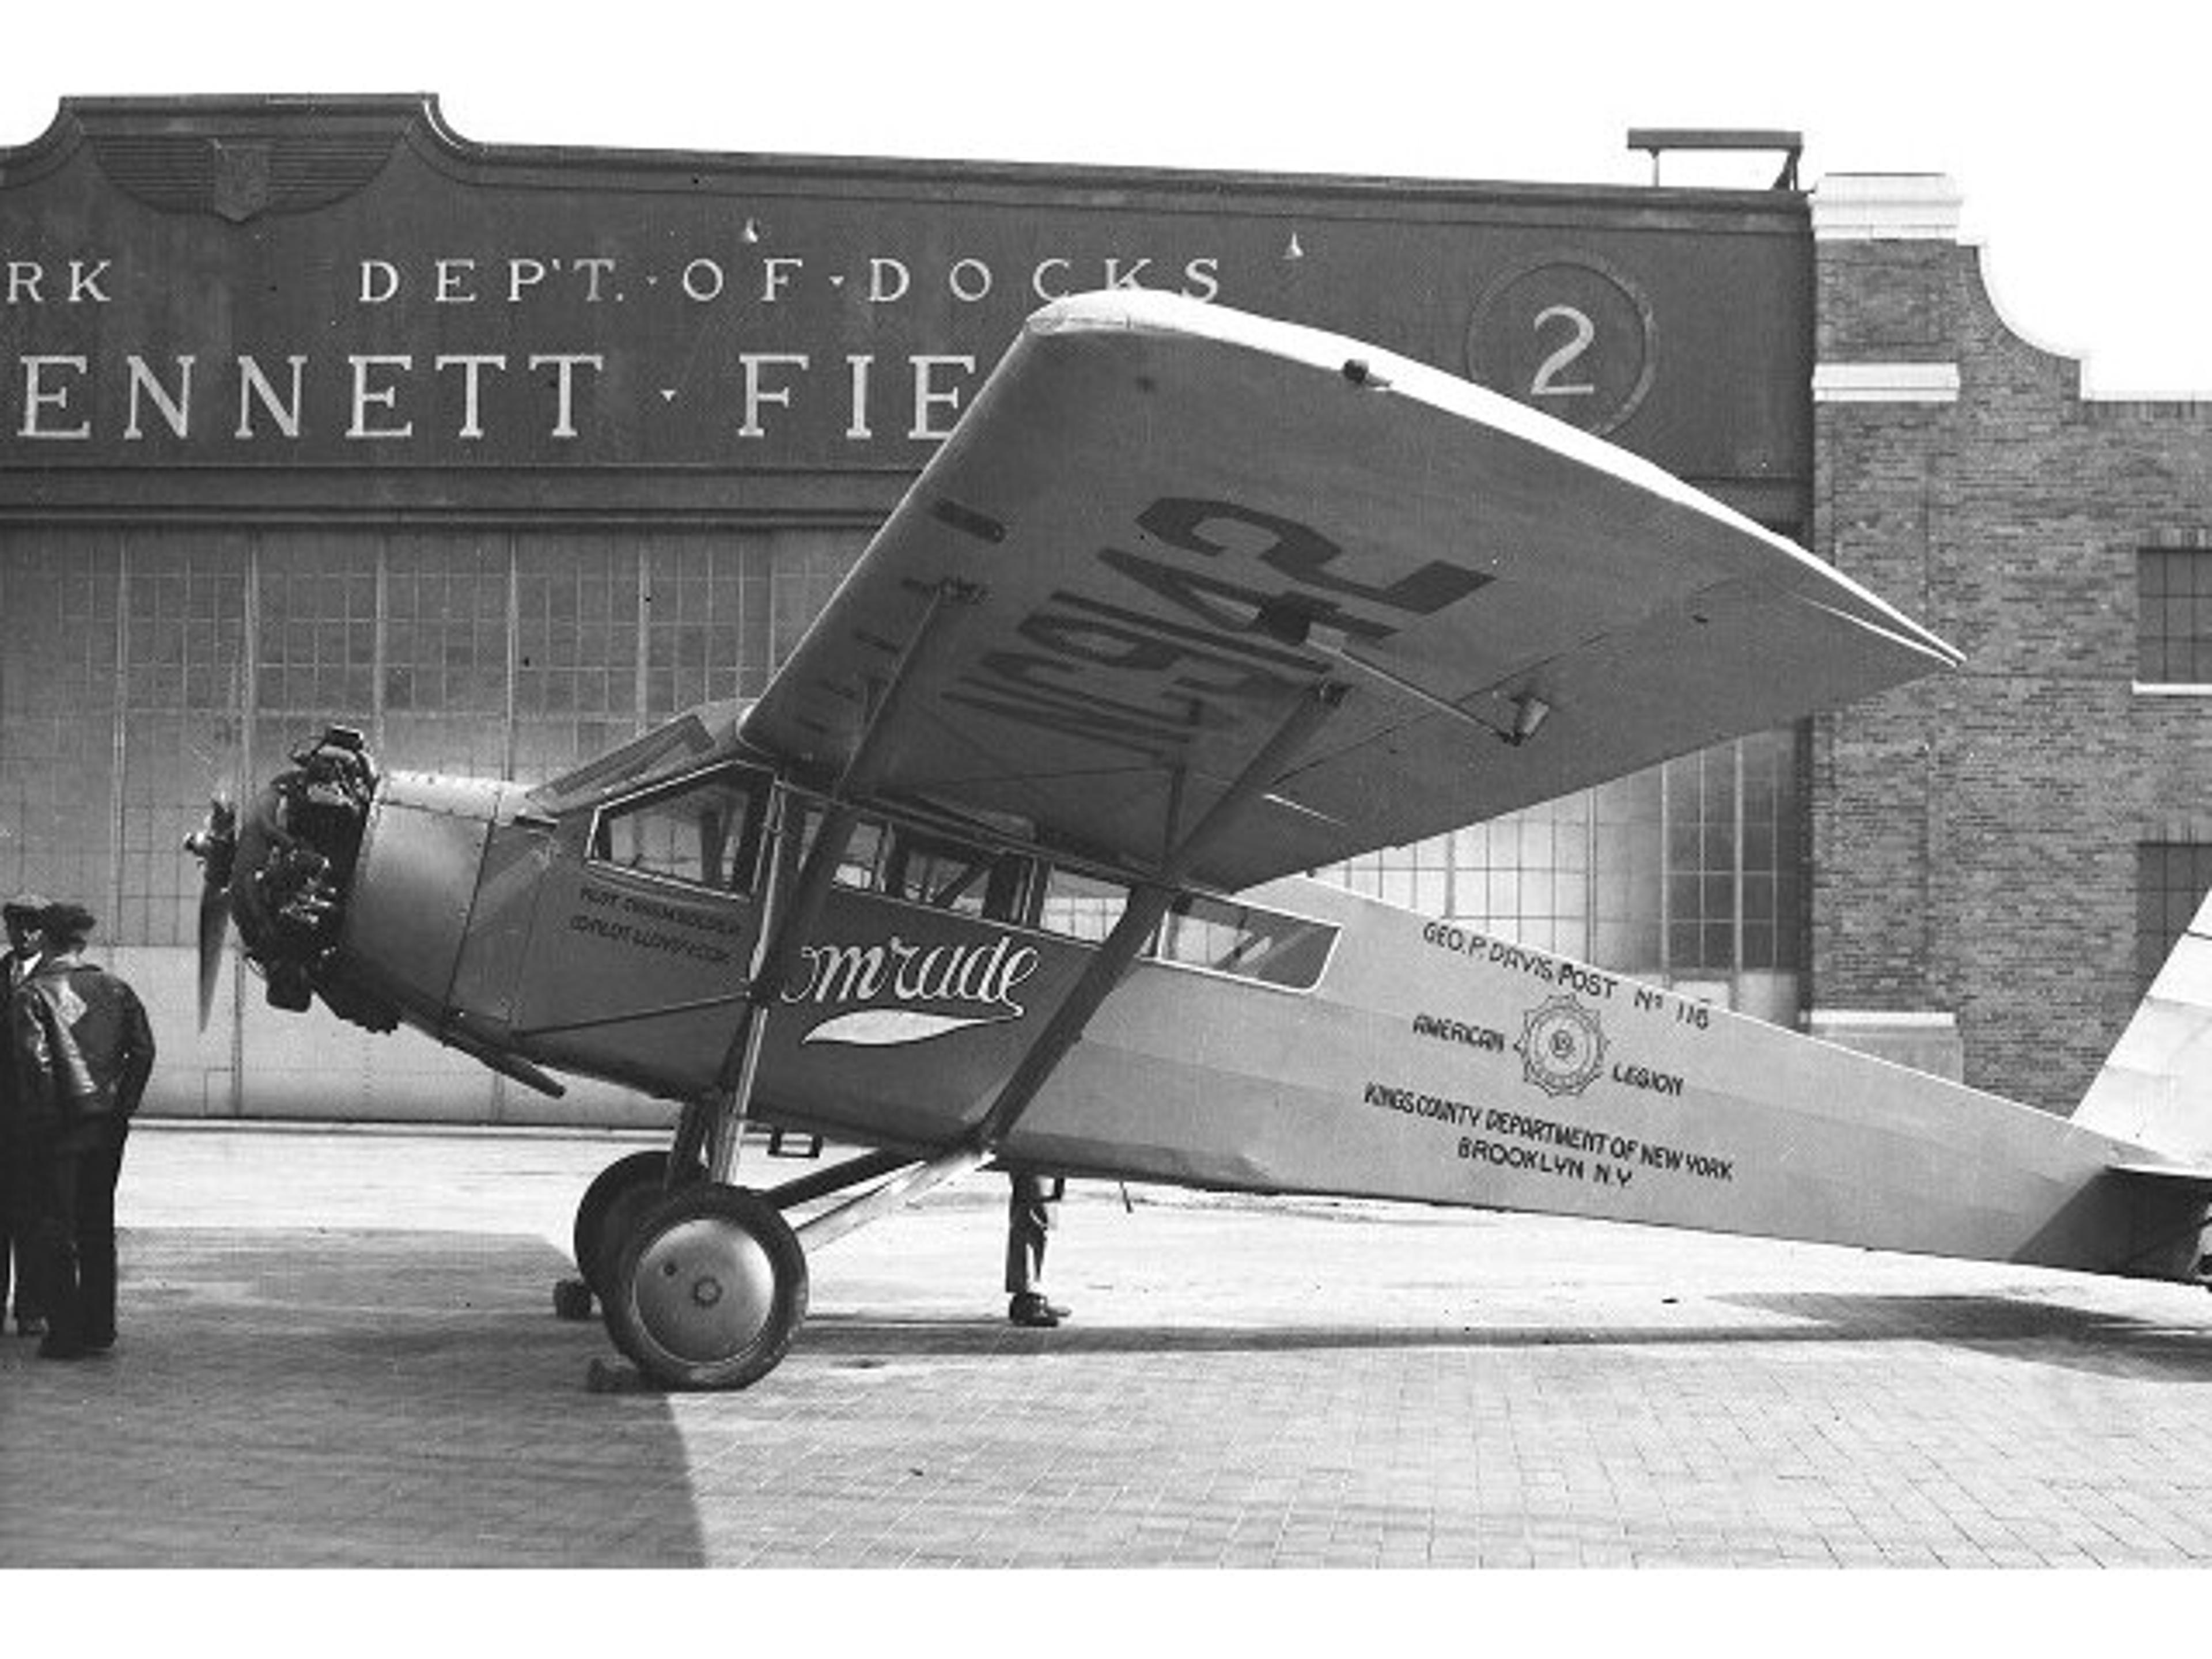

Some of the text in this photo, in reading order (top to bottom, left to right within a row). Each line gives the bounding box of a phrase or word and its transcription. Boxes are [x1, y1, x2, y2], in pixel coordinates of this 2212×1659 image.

[6, 261, 112, 302] RK
[682, 258, 802, 302] OF
[869, 257, 1218, 304] DOCKS
[1531, 304, 1594, 395] 2
[16, 354, 603, 440] ENNETT
[1489, 942, 1554, 981] DAVIS
[1558, 963, 1619, 999] POST
[1412, 1013, 1684, 1096] AMERICAN LEGION
[1364, 1082, 1733, 1182] KINGS COUNTY DEPARTMENT OF NEW YORK
[1457, 1136, 1585, 1180] BROOKLYN
